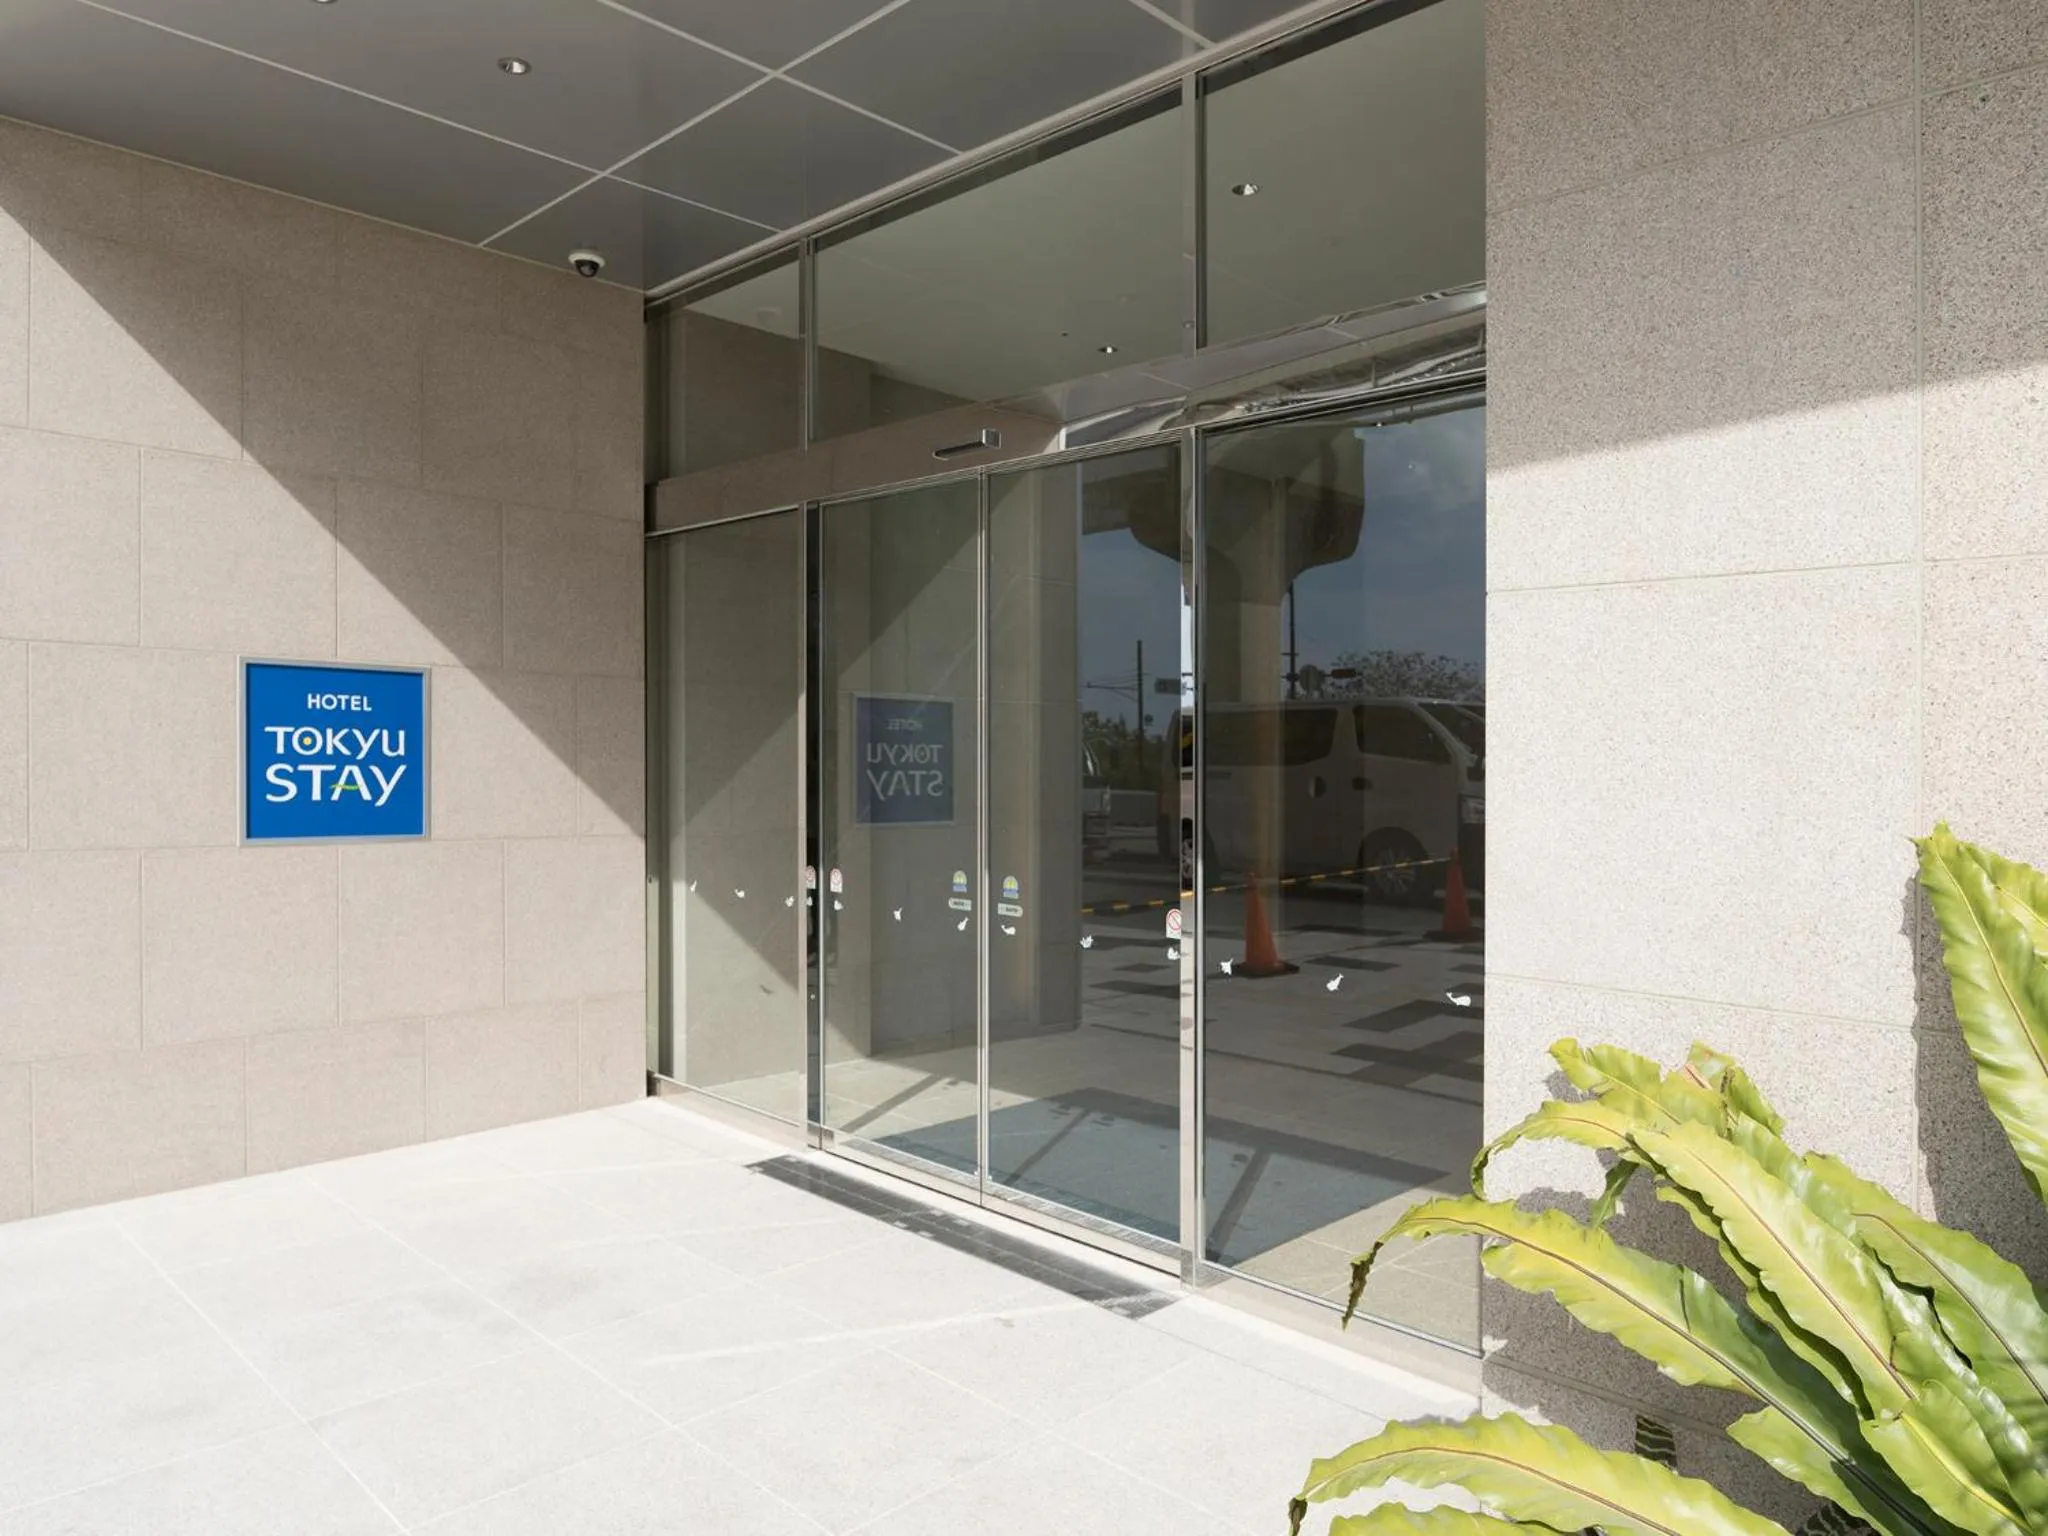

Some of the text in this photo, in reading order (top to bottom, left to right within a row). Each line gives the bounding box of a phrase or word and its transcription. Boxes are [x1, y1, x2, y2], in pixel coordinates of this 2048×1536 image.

[307, 693, 372, 712] HOTEL
[264, 726, 405, 760] TOKYU
[265, 763, 407, 807] STAY
